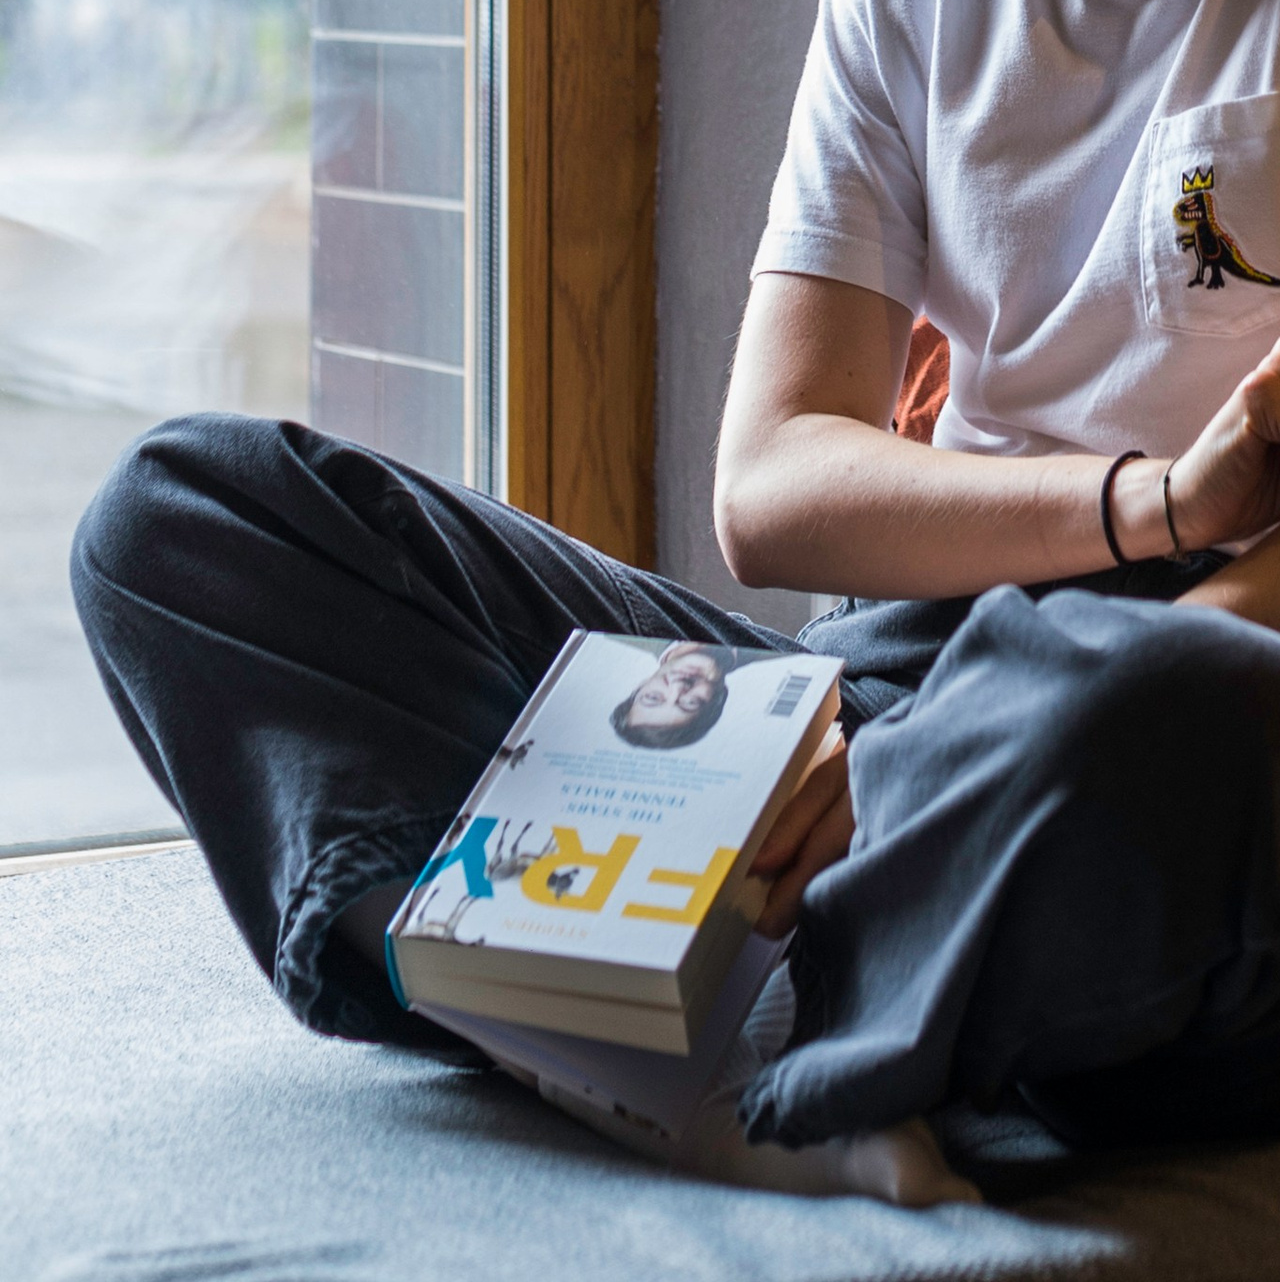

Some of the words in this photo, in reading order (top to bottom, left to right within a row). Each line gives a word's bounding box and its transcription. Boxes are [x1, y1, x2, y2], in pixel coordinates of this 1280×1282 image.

[560, 783, 616, 800] BALLS
[621, 790, 687, 809] TENNIS
[628, 809, 664, 824] THE
[411, 816, 742, 927] FRY
[502, 918, 589, 938] STEPHEN
